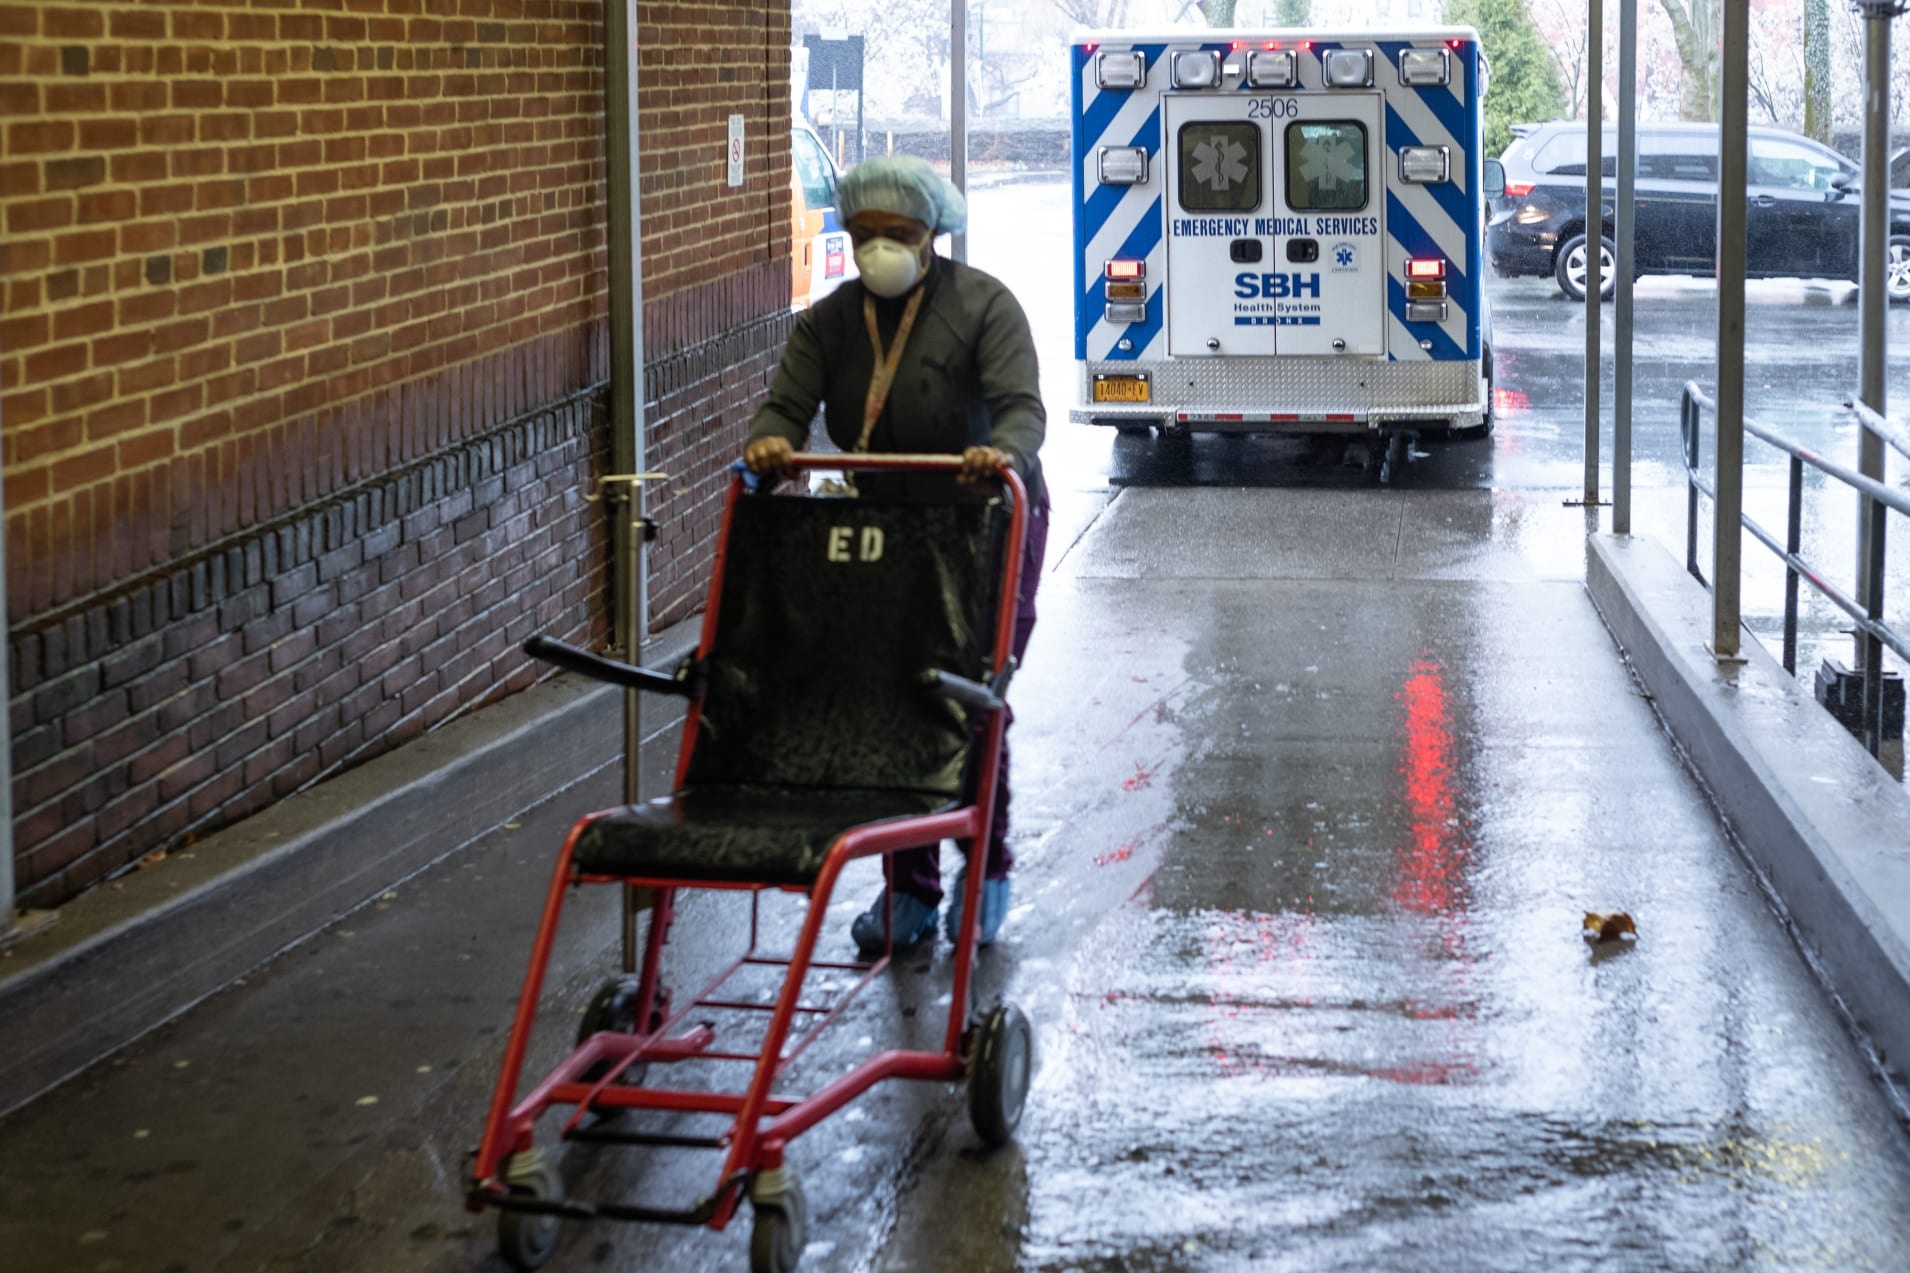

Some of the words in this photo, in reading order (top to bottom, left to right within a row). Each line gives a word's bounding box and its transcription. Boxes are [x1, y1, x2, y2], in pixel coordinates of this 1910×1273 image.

[1248, 98, 1298, 118] 2506
[1173, 218, 1249, 236] EMERGENCY
[1255, 218, 1310, 236] MEDICAL
[1316, 217, 1378, 235] SERVICES
[1234, 272, 1320, 298] SBH
[1234, 303, 1273, 312] Health
[1277, 303, 1321, 313] System
[827, 526, 885, 562] ED
